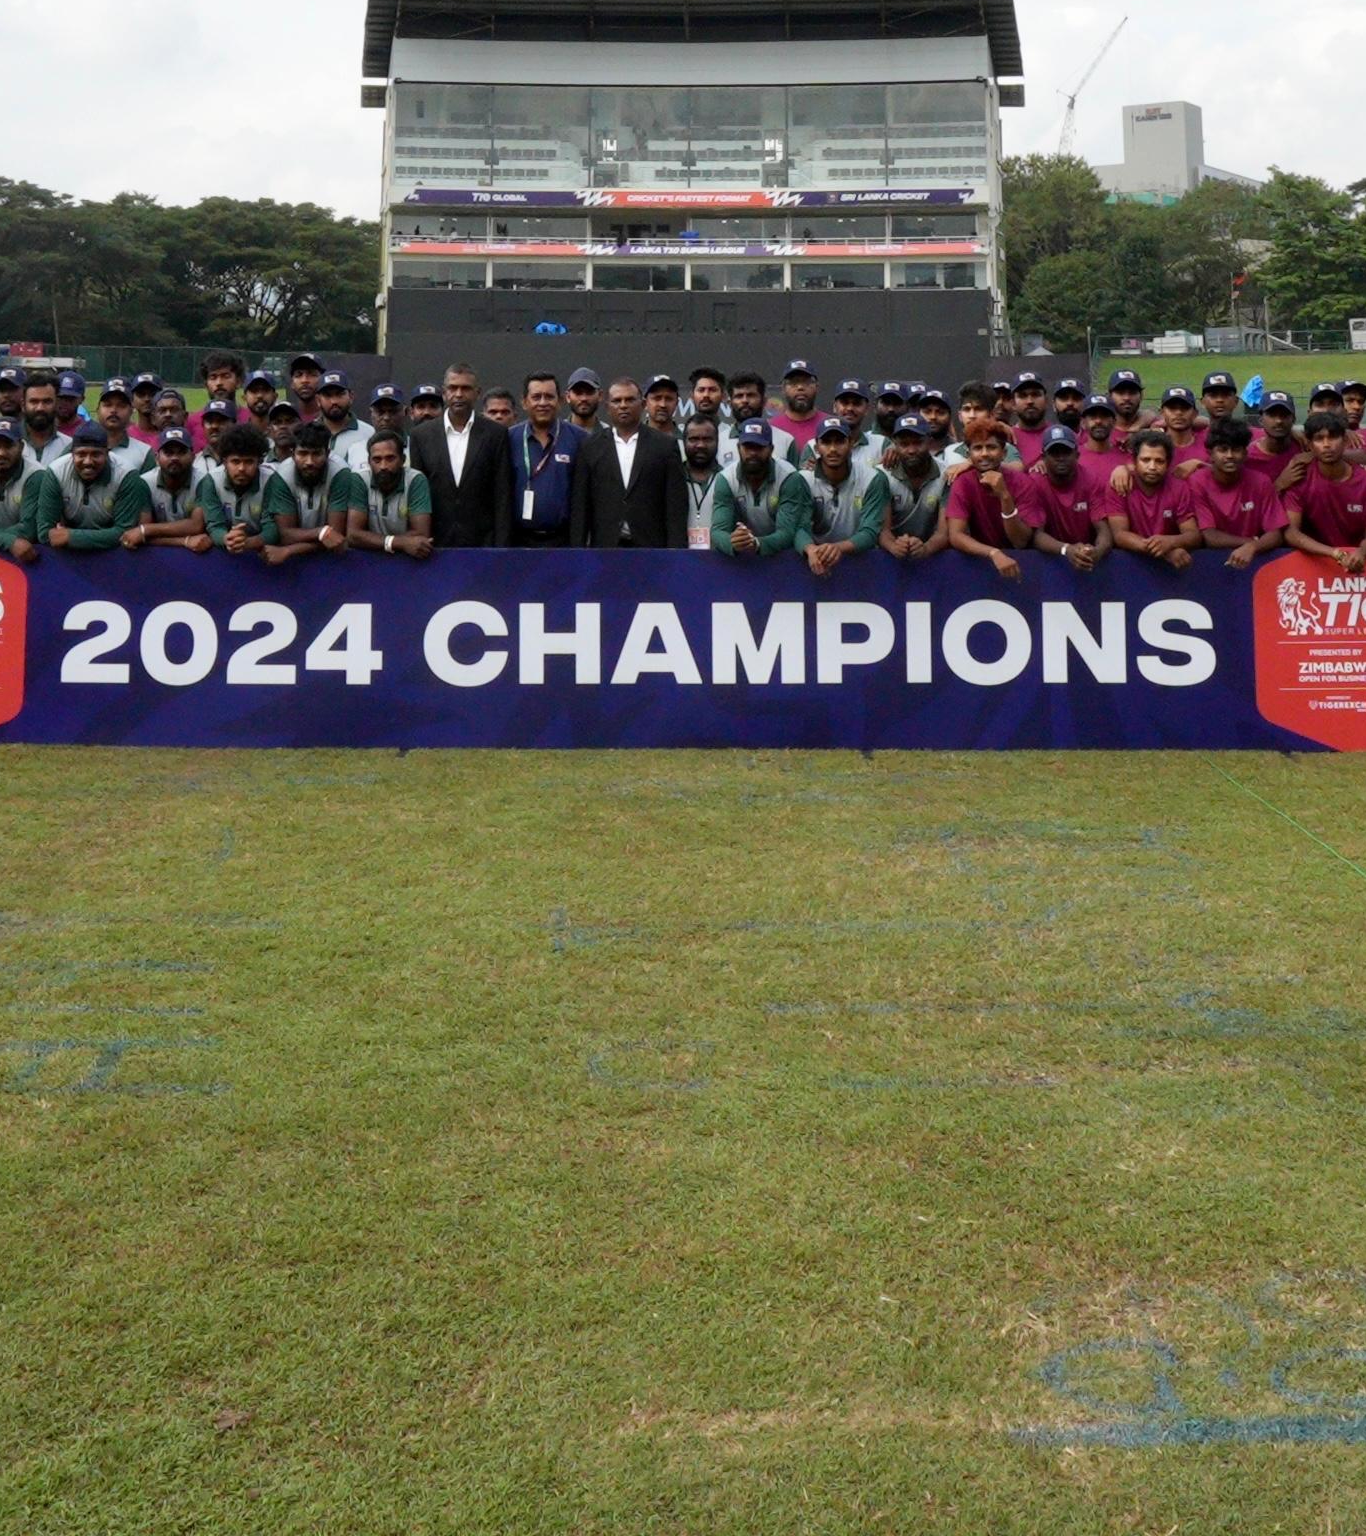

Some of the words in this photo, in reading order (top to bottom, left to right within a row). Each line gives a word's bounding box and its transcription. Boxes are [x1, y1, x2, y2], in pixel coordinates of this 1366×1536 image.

[492, 194, 528, 202] GLOBAL
[857, 192, 888, 200] LANKA
[889, 192, 930, 200] CRICKET
[630, 246, 662, 254] LANKA
[679, 246, 710, 254] SUPER
[710, 246, 746, 254] LEAGUE
[1325, 627, 1354, 635] SUPER
[61, 600, 383, 687] 2024
[423, 599, 1218, 688] CHAMPIONS
[1299, 674, 1320, 682] OPEN
[1321, 674, 1337, 682] FOR
